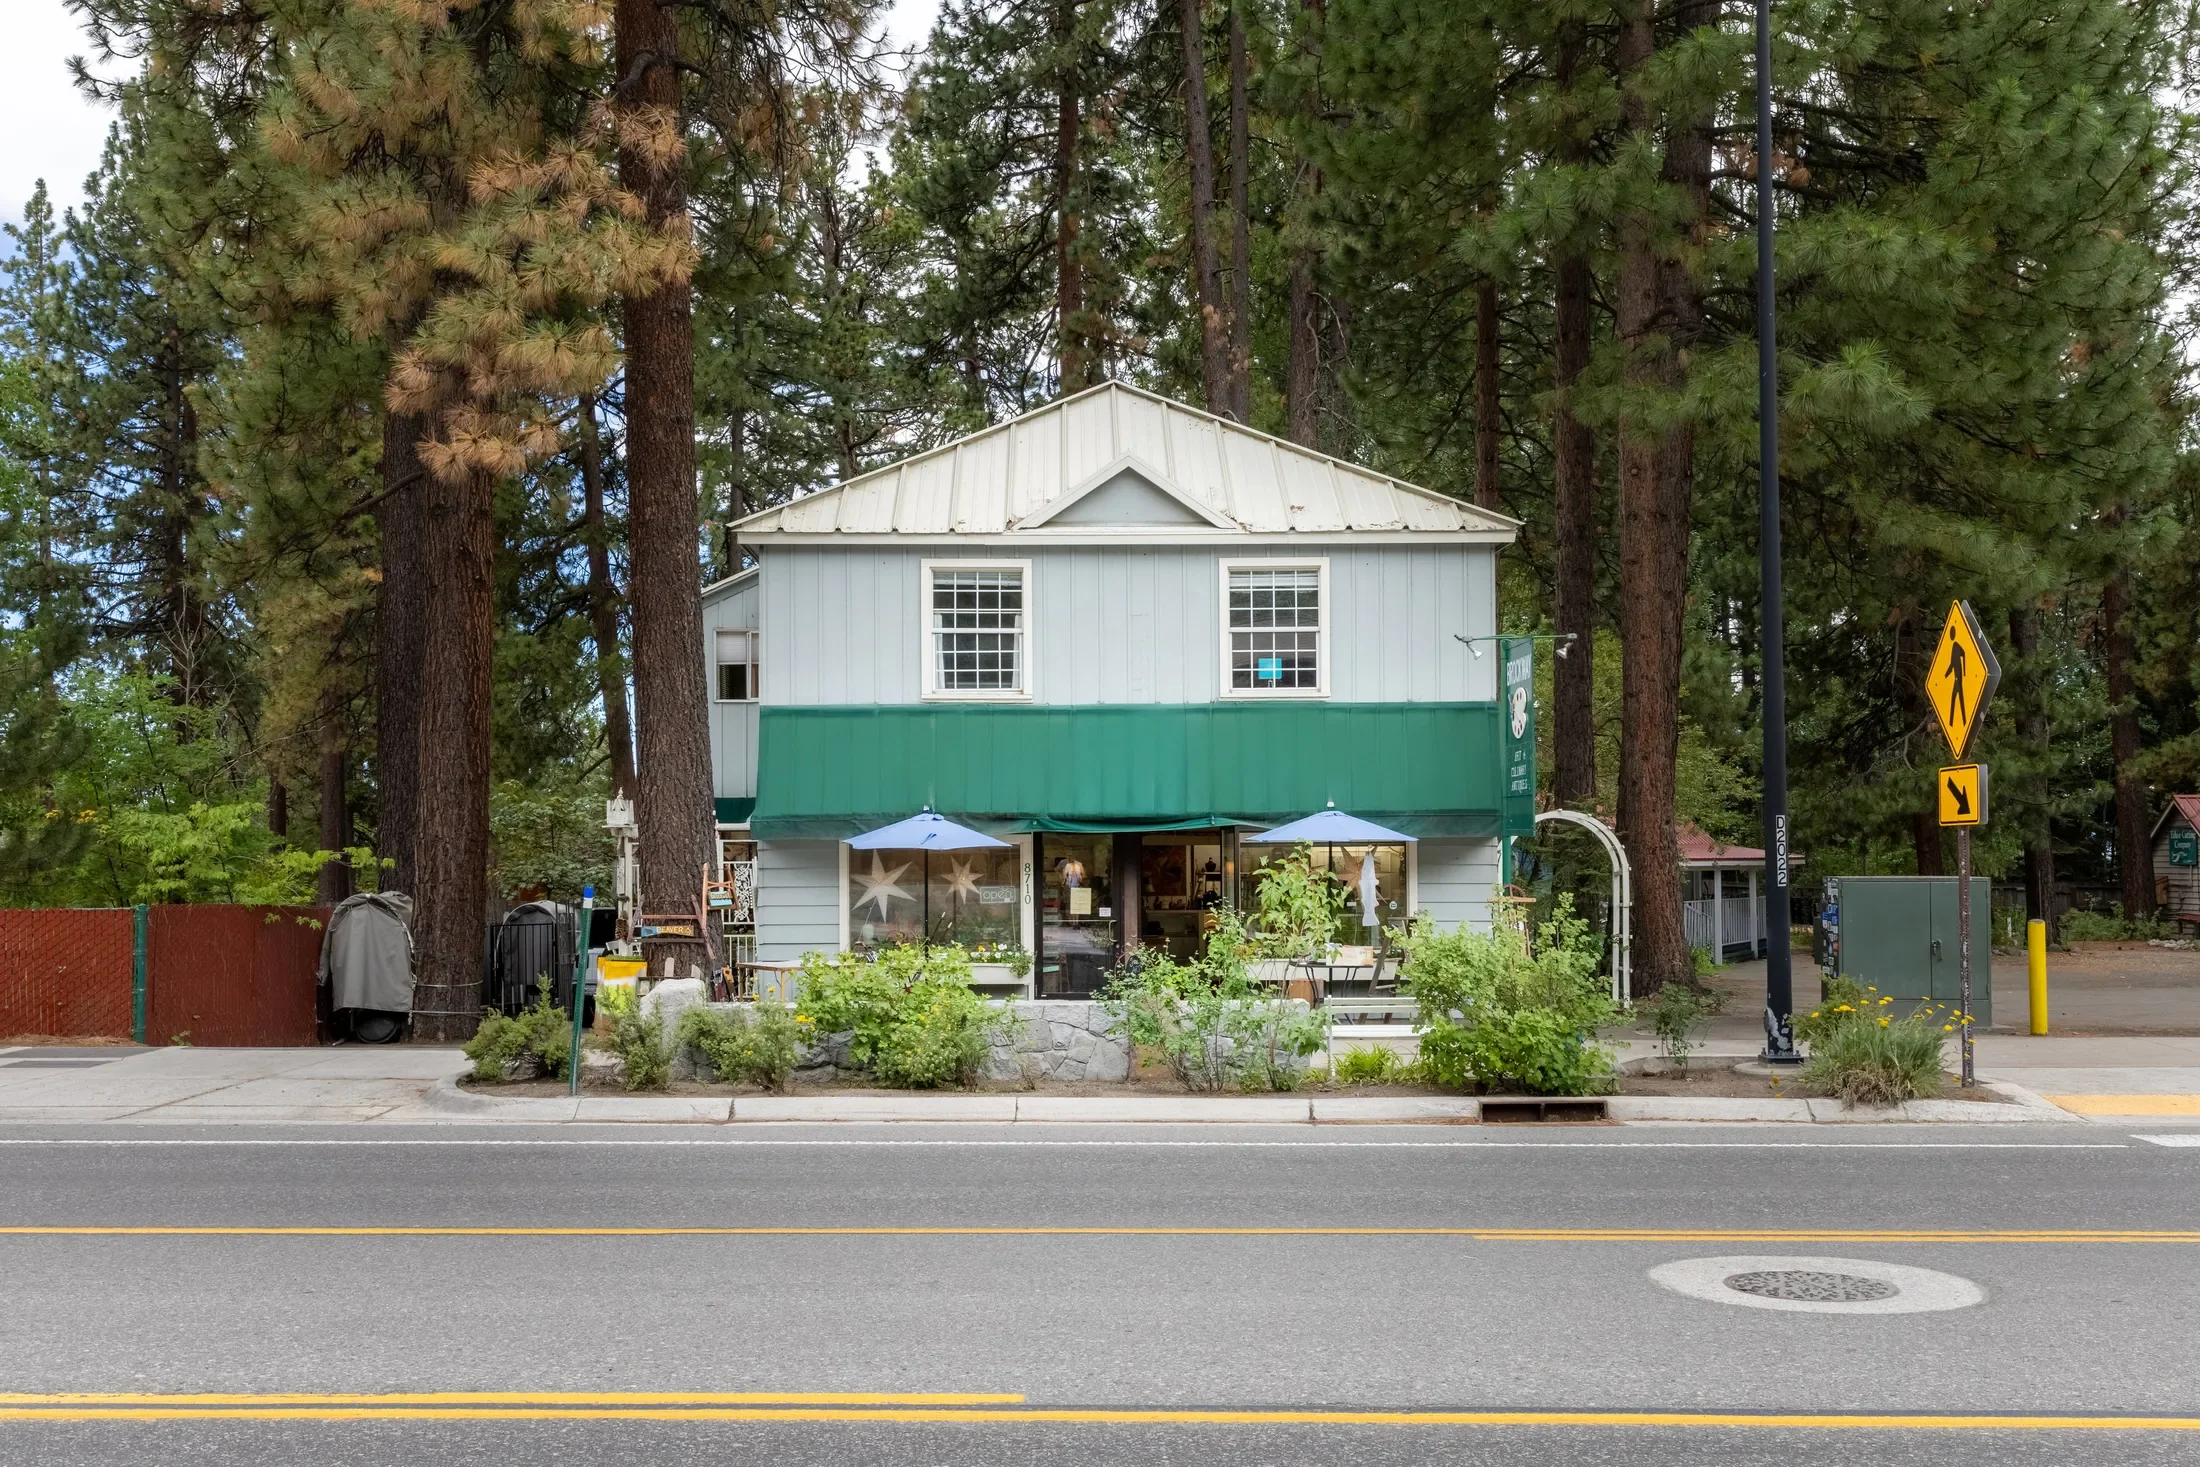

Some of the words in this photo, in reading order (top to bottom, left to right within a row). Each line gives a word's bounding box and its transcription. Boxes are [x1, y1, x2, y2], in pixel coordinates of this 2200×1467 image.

[1507, 653, 1531, 686] BROCKWAY
[1776, 816, 1786, 885] D2022
[983, 890, 1013, 901] open
